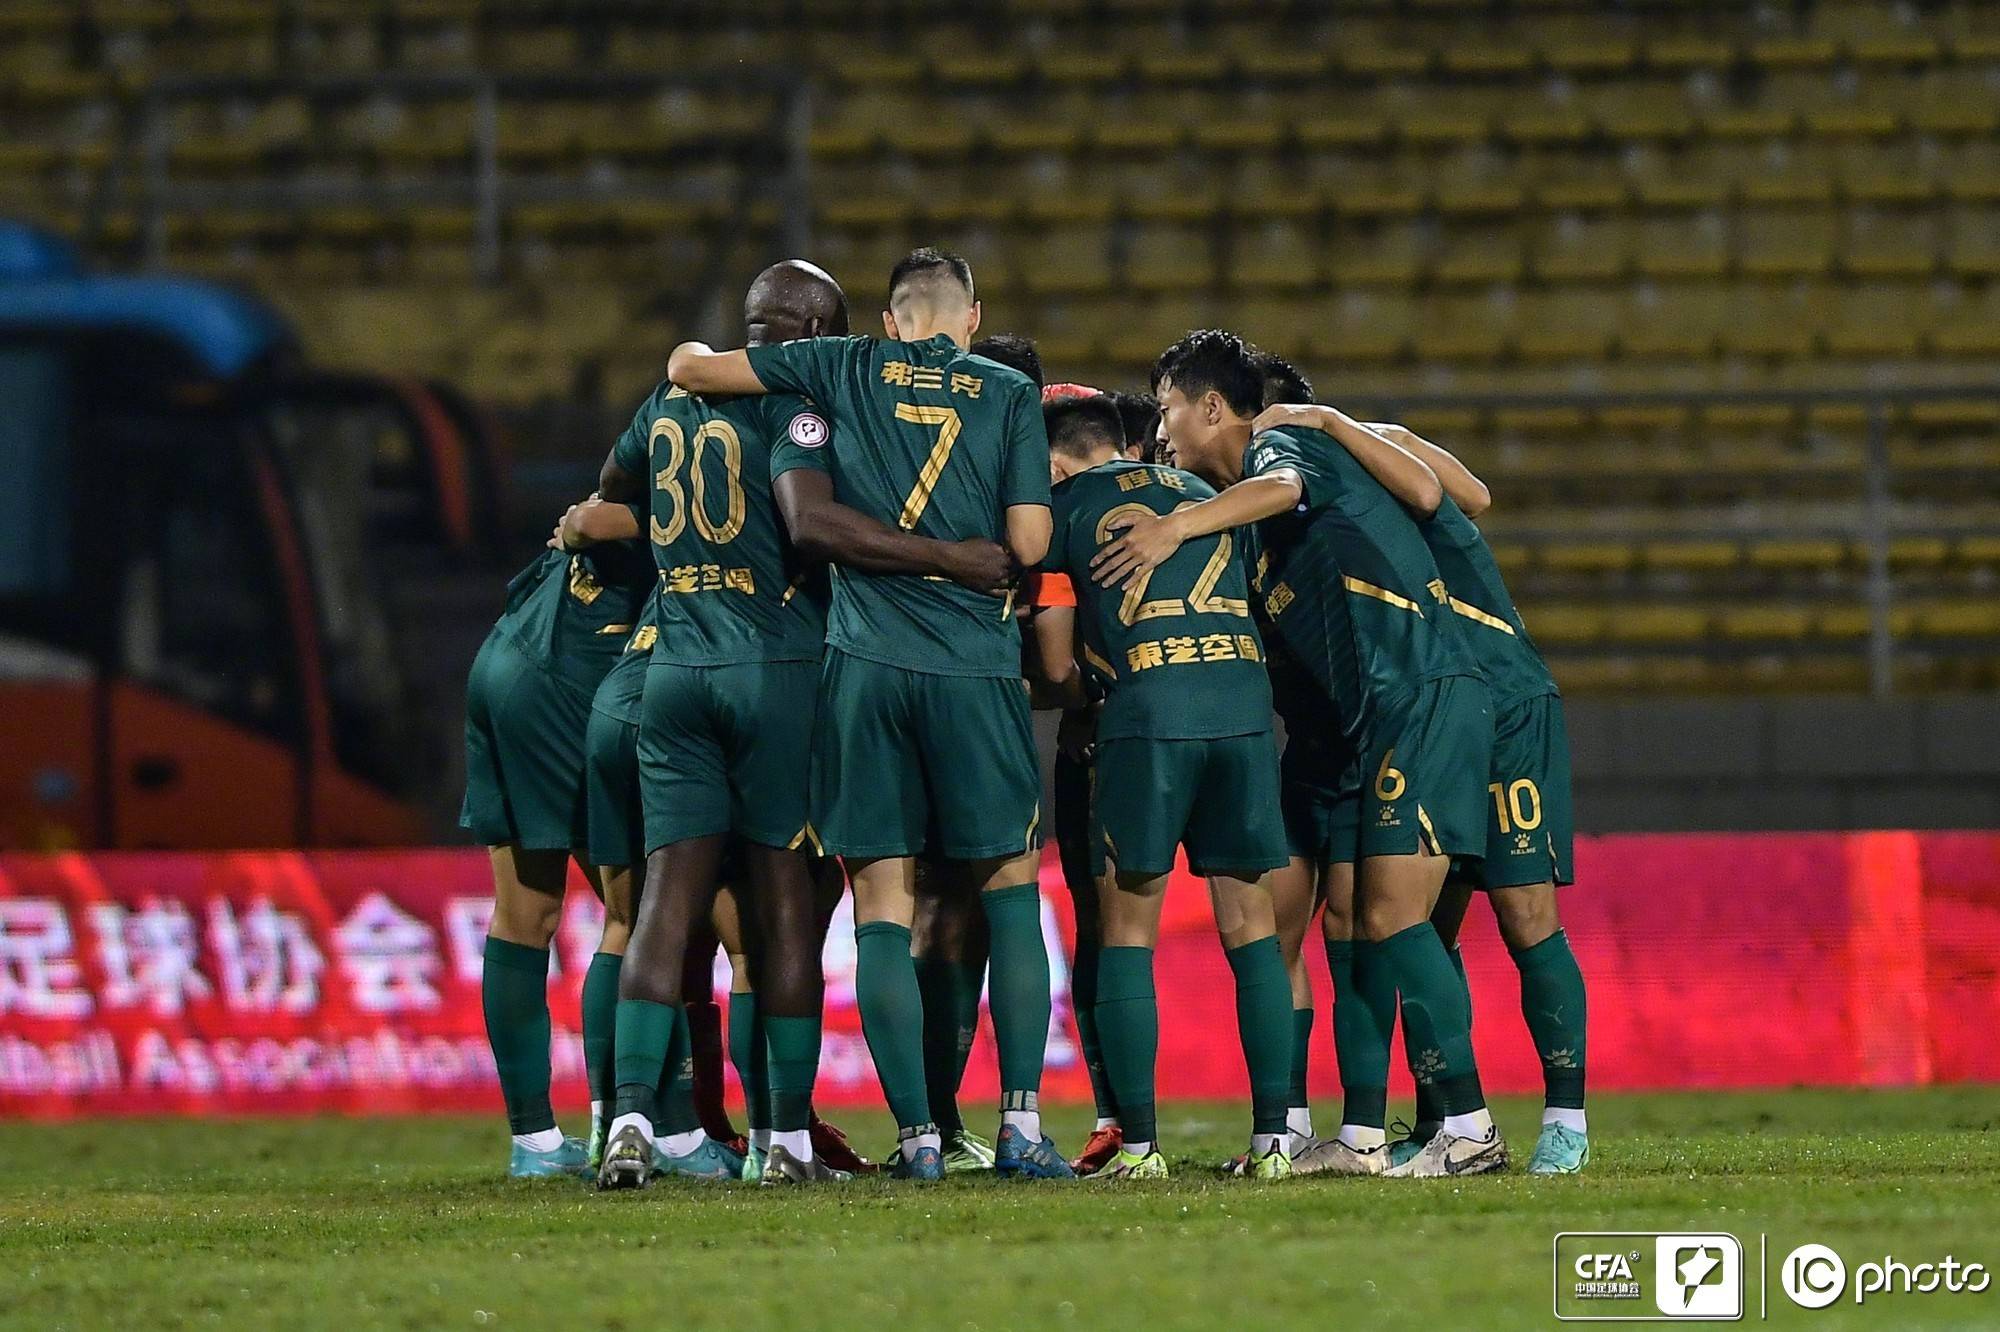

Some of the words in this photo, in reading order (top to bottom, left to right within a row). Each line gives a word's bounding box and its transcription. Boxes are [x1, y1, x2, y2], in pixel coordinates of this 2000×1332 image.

[649, 417, 747, 547] 30
[894, 402, 963, 530] 7
[1375, 749, 1406, 801] 6
[1488, 778, 1542, 834] 10
